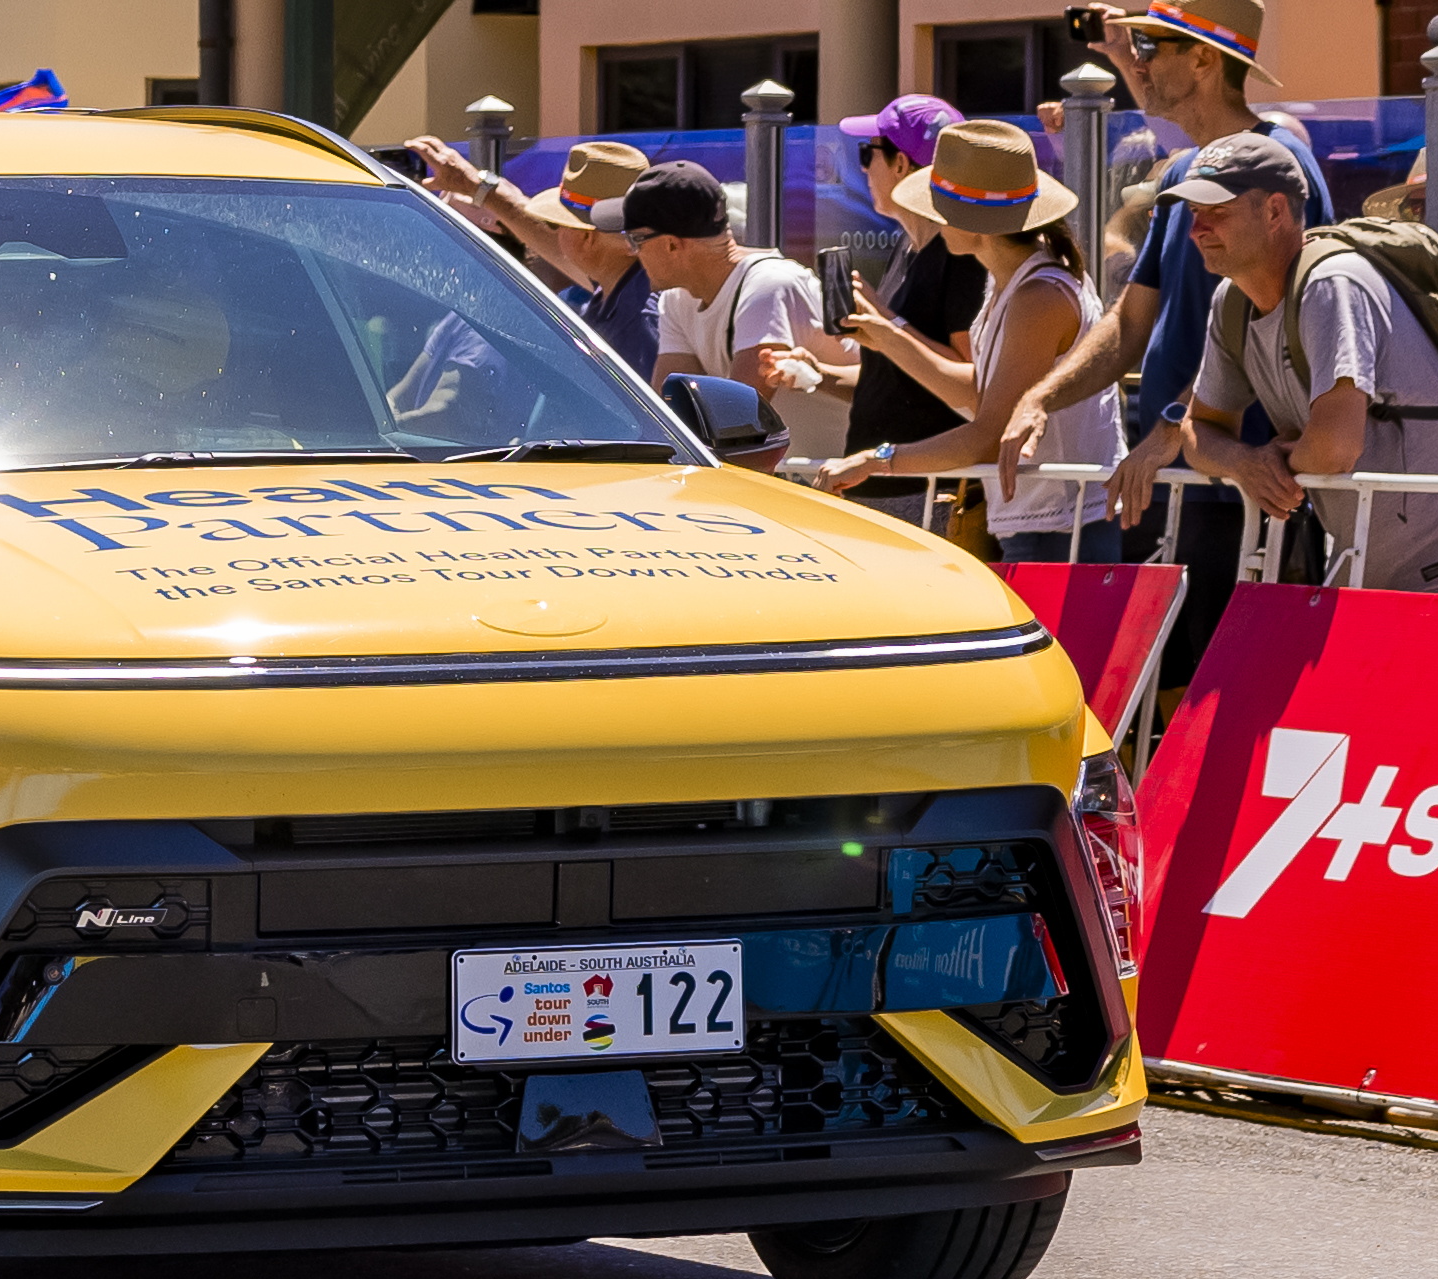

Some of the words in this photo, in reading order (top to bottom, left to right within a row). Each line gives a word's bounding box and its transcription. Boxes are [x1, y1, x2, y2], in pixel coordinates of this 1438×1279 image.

[26, 509, 766, 553] Partners
[115, 566, 216, 583] The
[227, 551, 406, 572] Official
[416, 546, 579, 564] Health
[584, 547, 759, 563] Partner
[776, 551, 821, 566] of
[155, 583, 238, 601] the
[247, 570, 417, 592] Santos
[421, 567, 532, 582] Tour
[545, 565, 688, 579] Down
[695, 564, 839, 584] Under
[116, 915, 155, 924] Line
[503, 959, 567, 975] ADELAIDE
[579, 957, 623, 971] SOUTH
[625, 954, 696, 969] AUSTRALIA
[524, 982, 571, 995] Santos
[535, 997, 571, 1010] tour
[636, 969, 734, 1036] 122
[527, 1012, 571, 1027] down
[523, 1028, 572, 1043] under
